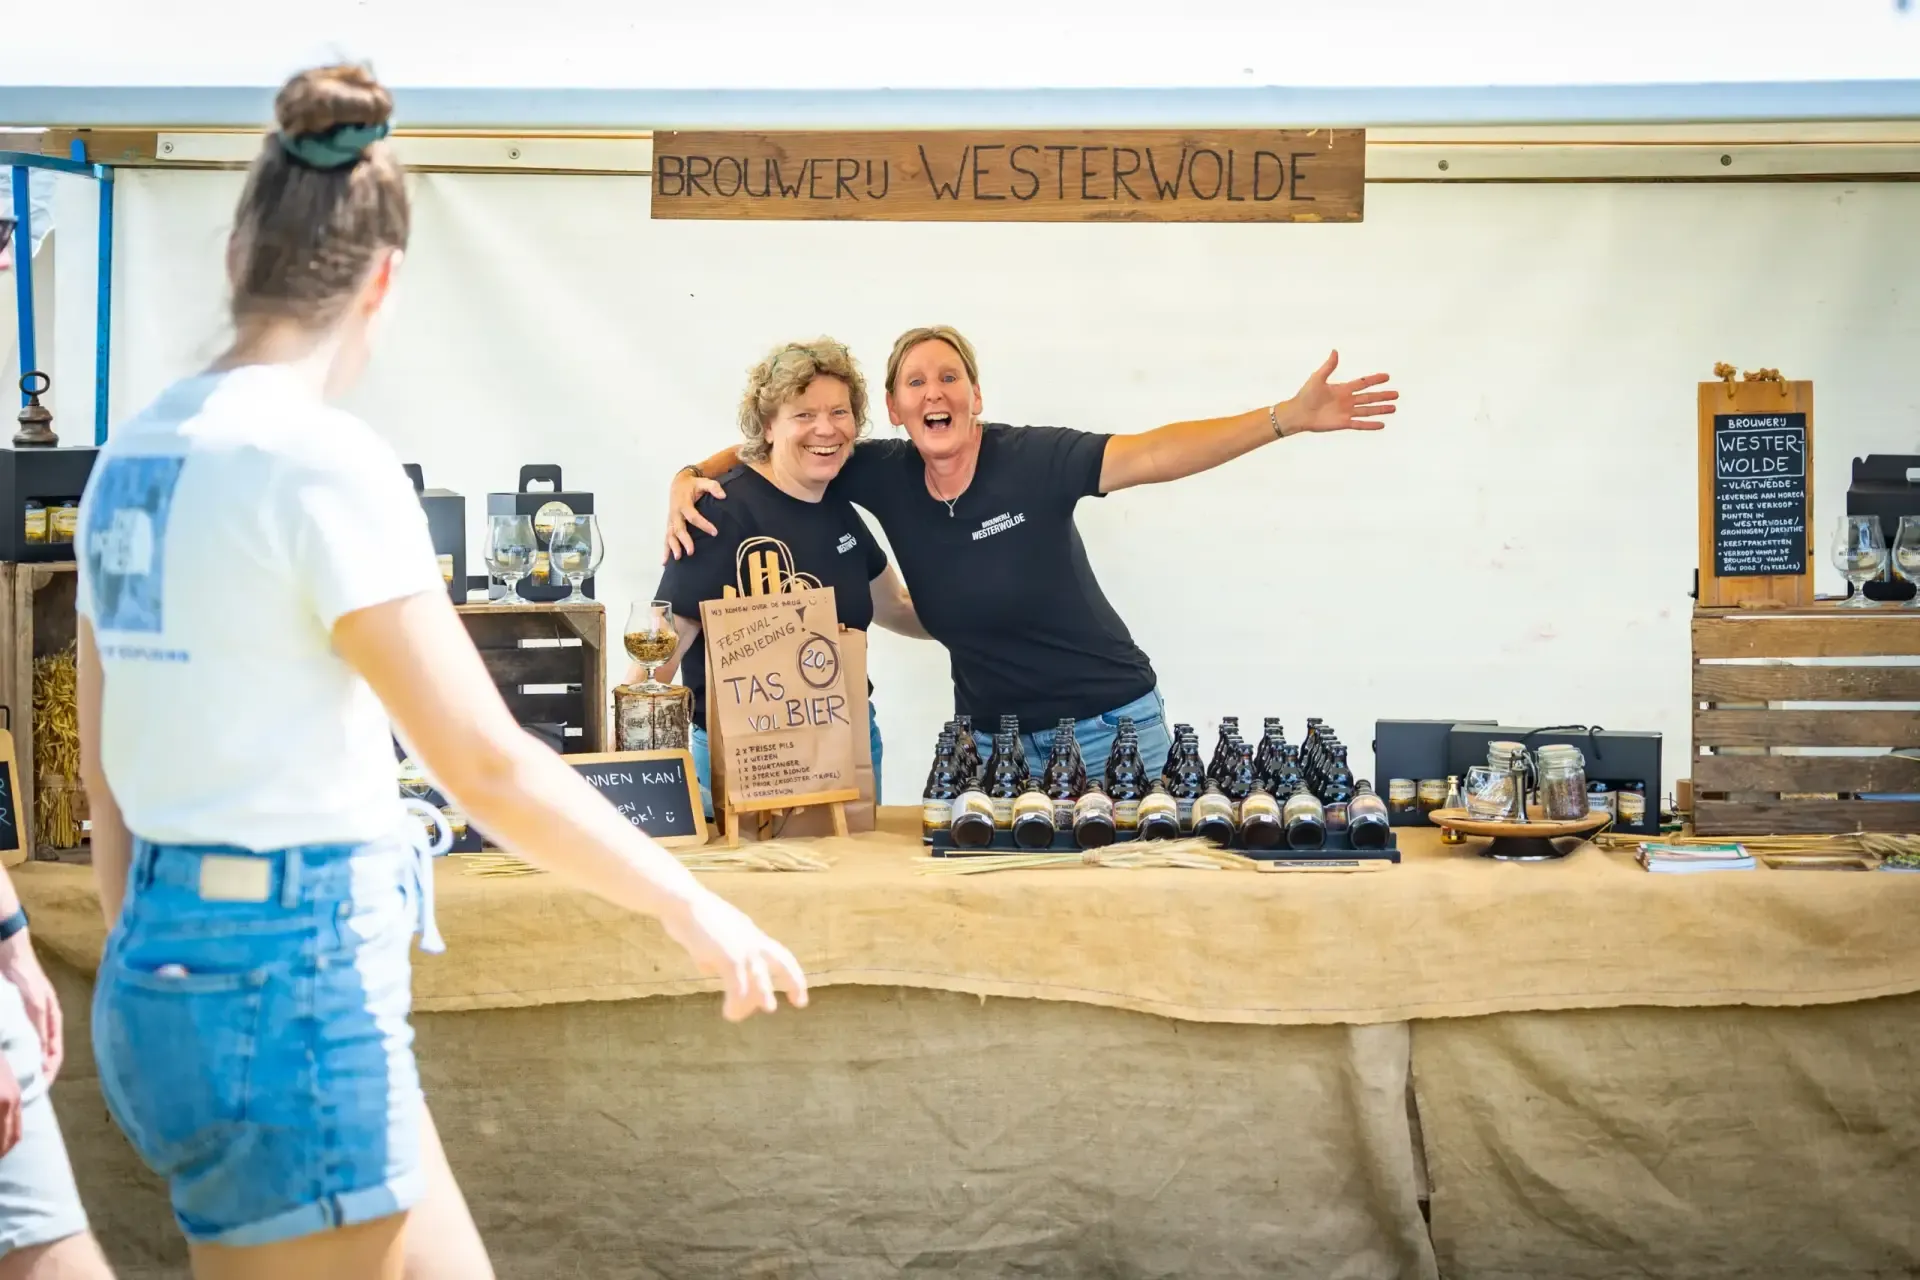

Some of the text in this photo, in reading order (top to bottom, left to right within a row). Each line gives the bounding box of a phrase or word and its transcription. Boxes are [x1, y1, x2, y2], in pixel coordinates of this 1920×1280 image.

[658, 144, 1317, 202] BROUWERIJ WESTERWOLDE
[1728, 417, 1787, 429] BROUWERIJ
[1719, 456, 1790, 473] WOLDE
[1721, 490, 1805, 501] LEVERING AAN HORECA
[1735, 502, 1754, 510] VELE
[1721, 512, 1753, 521] PUNTEN
[971, 512, 1026, 541] WESTERWOLDE
[1723, 549, 1754, 557] VERKOOP
[751, 603, 768, 611] OVER
[723, 672, 785, 704] TAS
[748, 694, 850, 732] VOL BIER
[748, 743, 777, 754] FRISSE
[779, 741, 795, 750] PILS
[750, 753, 779, 763] WEIZEN
[751, 759, 800, 772] BOURTANGER
[751, 771, 780, 781] STERKE
[783, 766, 810, 775] BLONDE
